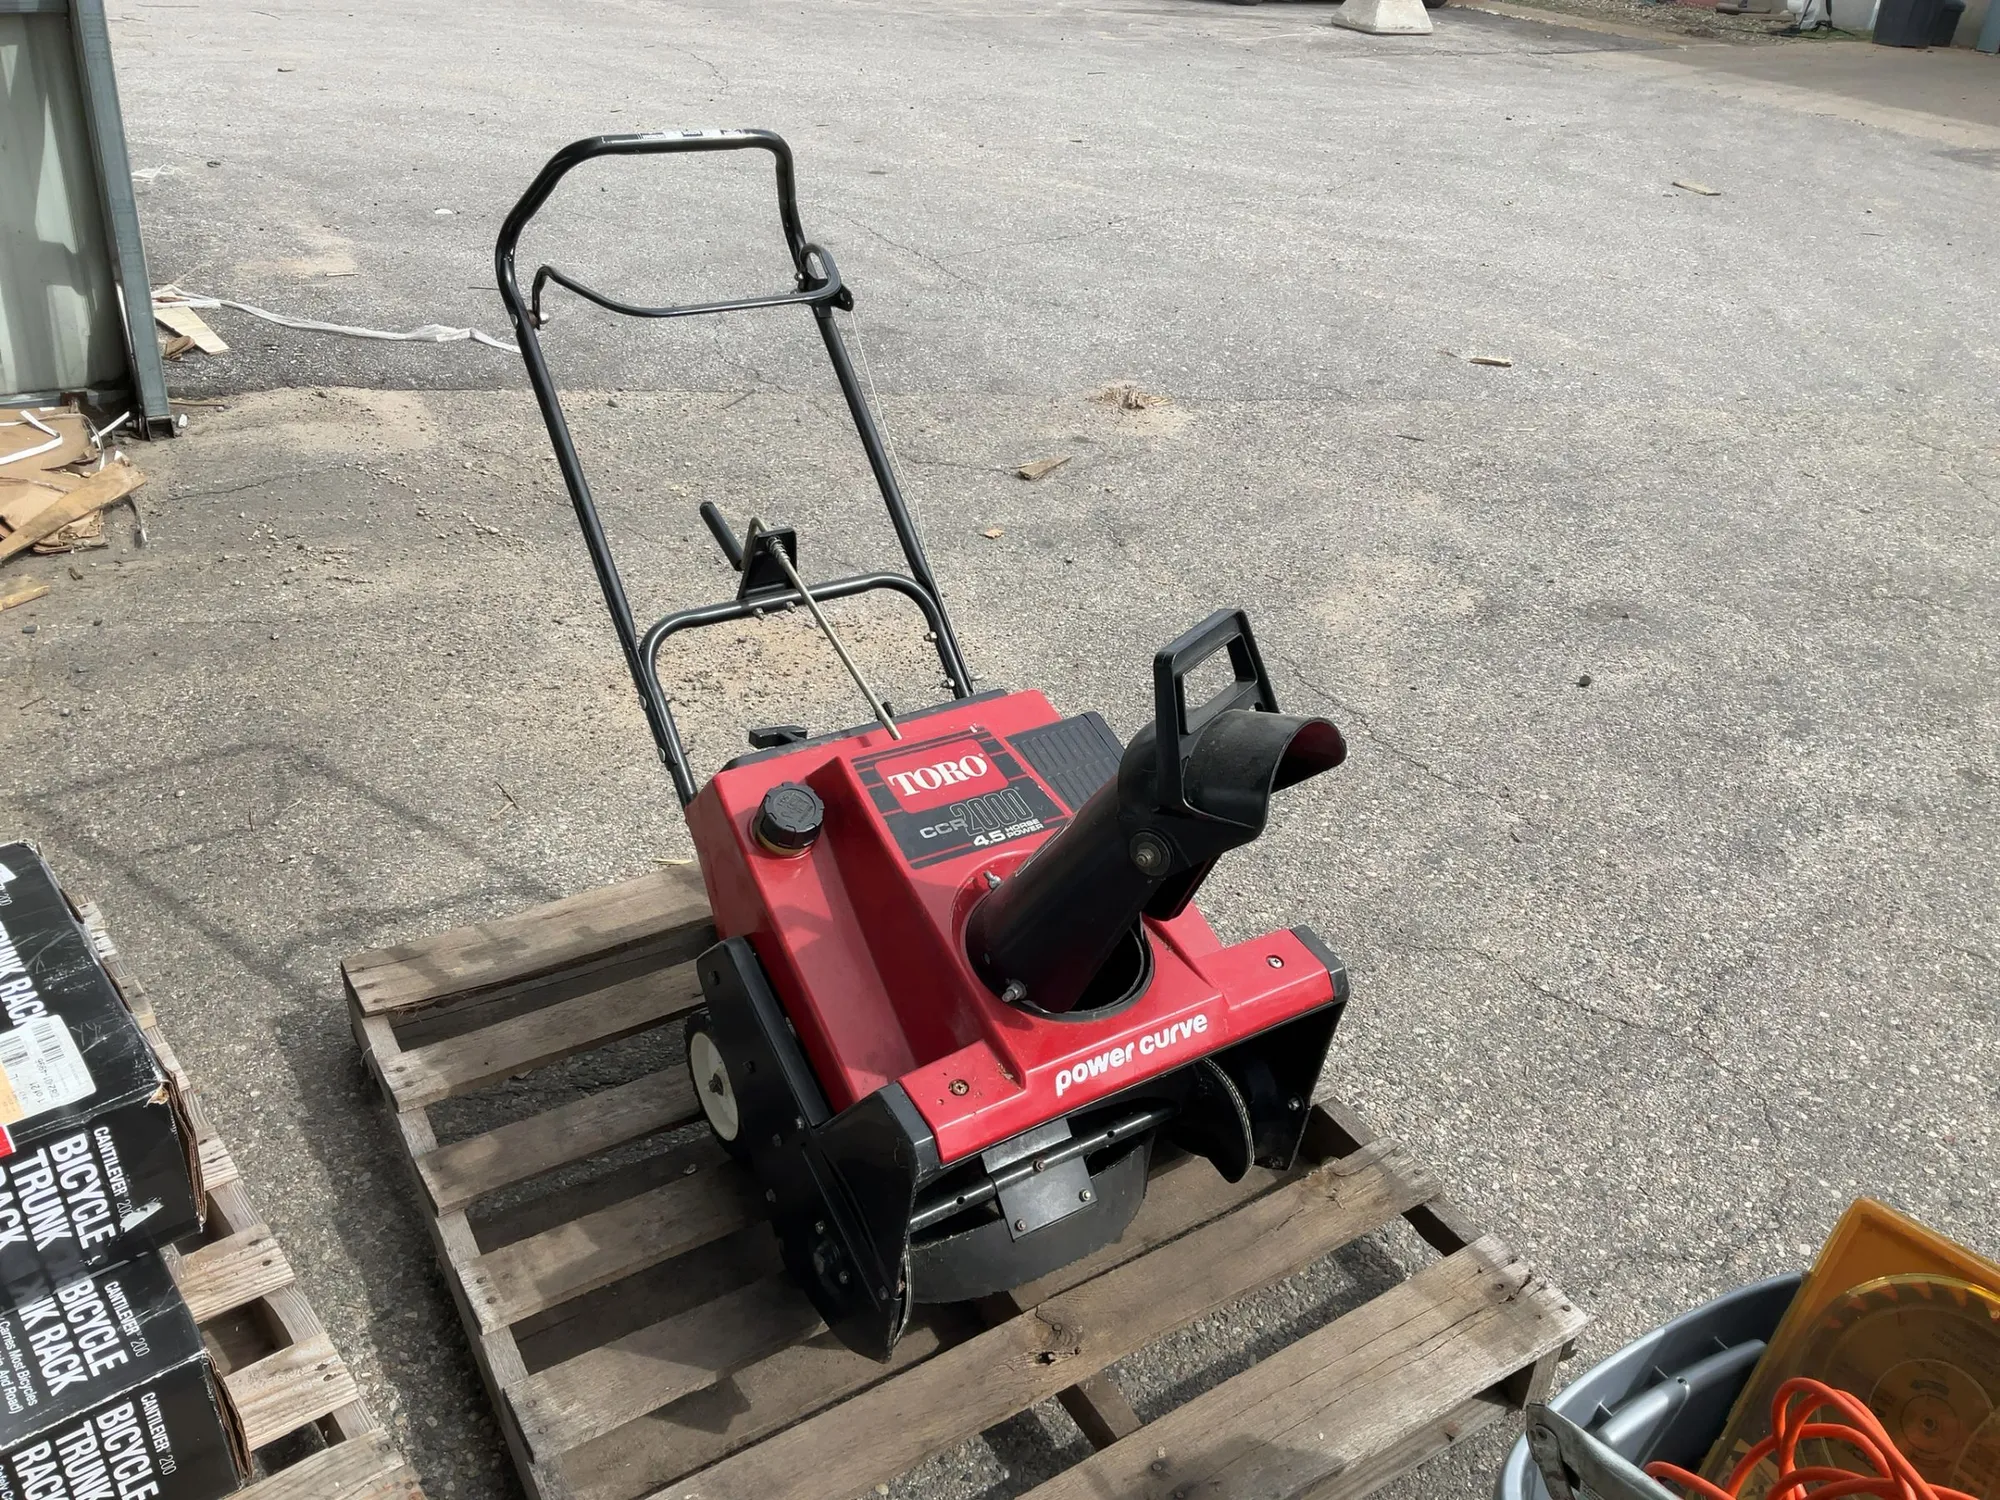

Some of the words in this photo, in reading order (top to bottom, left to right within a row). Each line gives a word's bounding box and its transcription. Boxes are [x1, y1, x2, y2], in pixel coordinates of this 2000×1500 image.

[887, 755, 987, 797] TORO
[973, 830, 1006, 846] 4.5
[1004, 818, 1041, 832] HORSE
[1006, 823, 1044, 839] POWER
[1055, 1041, 1135, 1098] power
[1139, 1014, 1208, 1055] curve
[50, 1132, 116, 1250] BICYCLE
[94, 1126, 127, 1197] CANTILEVER
[9, 1147, 73, 1252] TRUNK
[0, 1320, 16, 1350] Carries
[57, 1278, 129, 1378] BICYCLE
[104, 1280, 139, 1337] CANTILEVER
[130, 1337, 150, 1358] 200
[8, 1348, 26, 1372] Most
[16, 1369, 38, 1407] Bicycles
[29, 1322, 89, 1397] RACK
[3, 1385, 24, 1414] Road)
[141, 1391, 170, 1453] CANTILEVER
[159, 1454, 177, 1476] 200
[55, 1419, 115, 1500] TRUNK
[95, 1401, 159, 1500] BICYCLE
